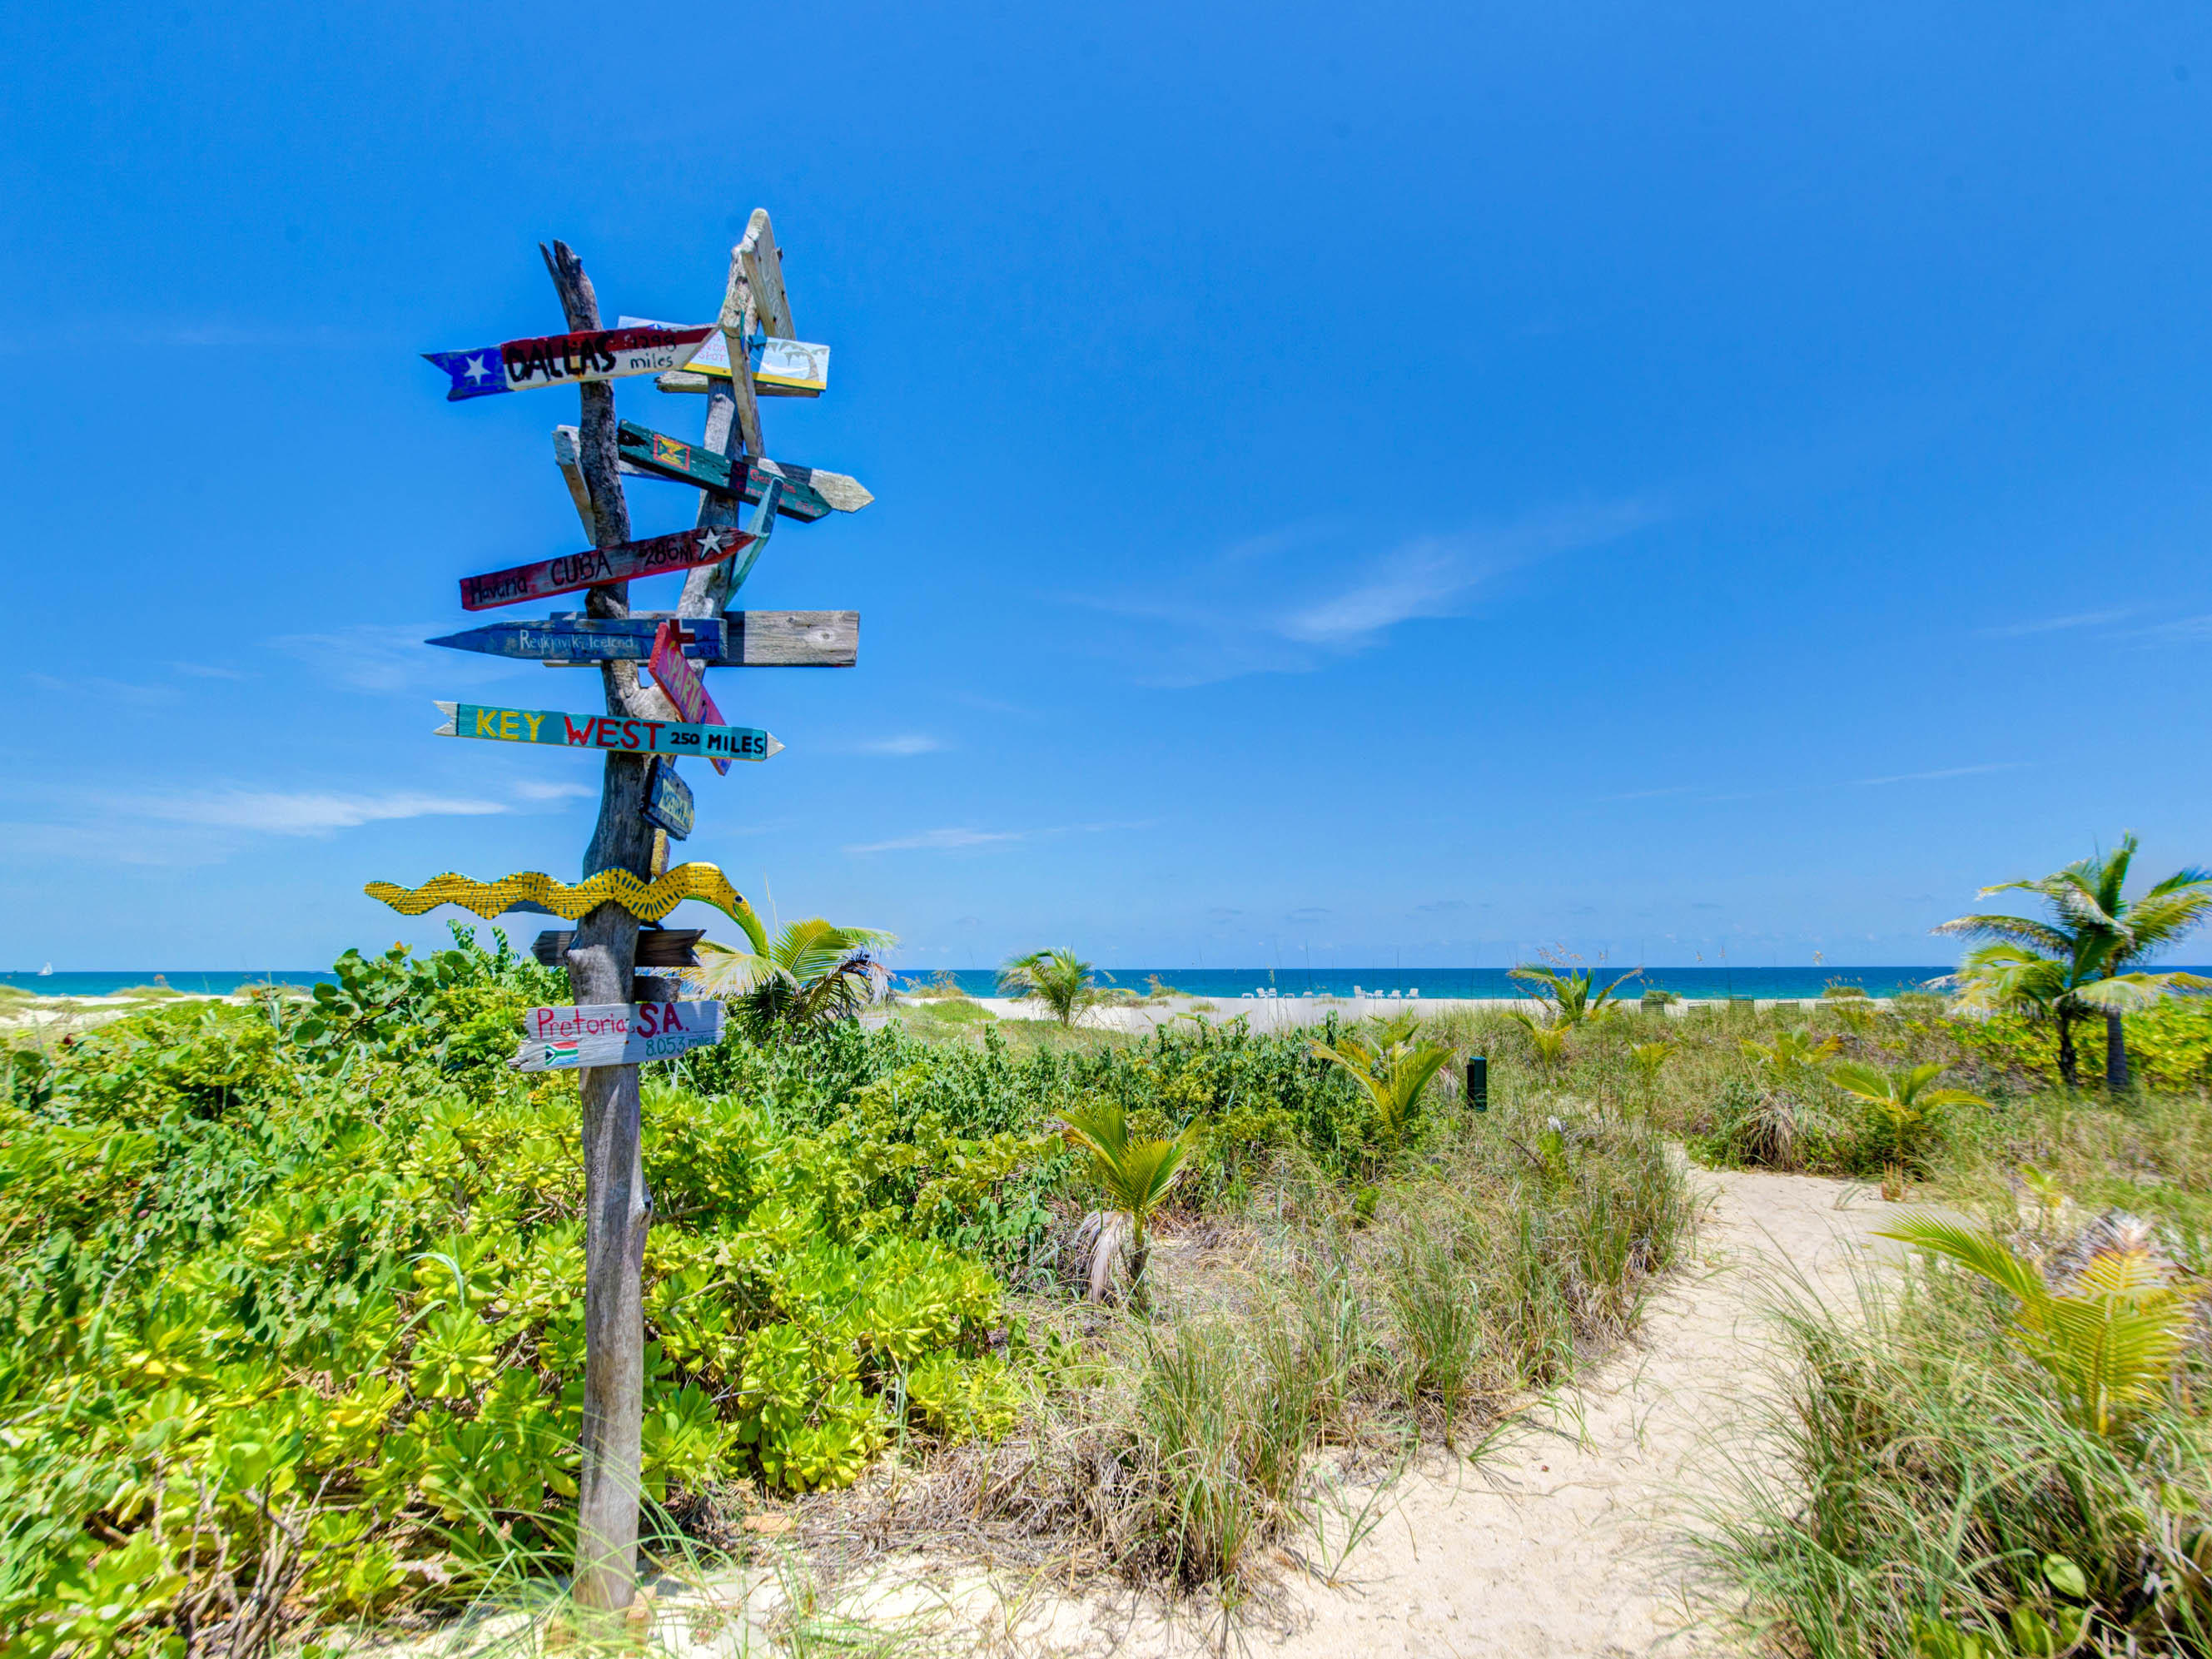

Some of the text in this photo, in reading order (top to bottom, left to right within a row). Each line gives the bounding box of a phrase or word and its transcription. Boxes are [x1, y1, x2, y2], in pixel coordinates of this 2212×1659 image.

[506, 331, 616, 383] DALLAS
[630, 352, 674, 369] miles
[470, 574, 528, 605] Havana
[550, 549, 614, 586] CUBA
[589, 633, 634, 648] Iceland
[475, 708, 764, 754] KEY WEST 250 MILES
[637, 1002, 689, 1038] S.A.
[688, 1036, 717, 1046] miles
